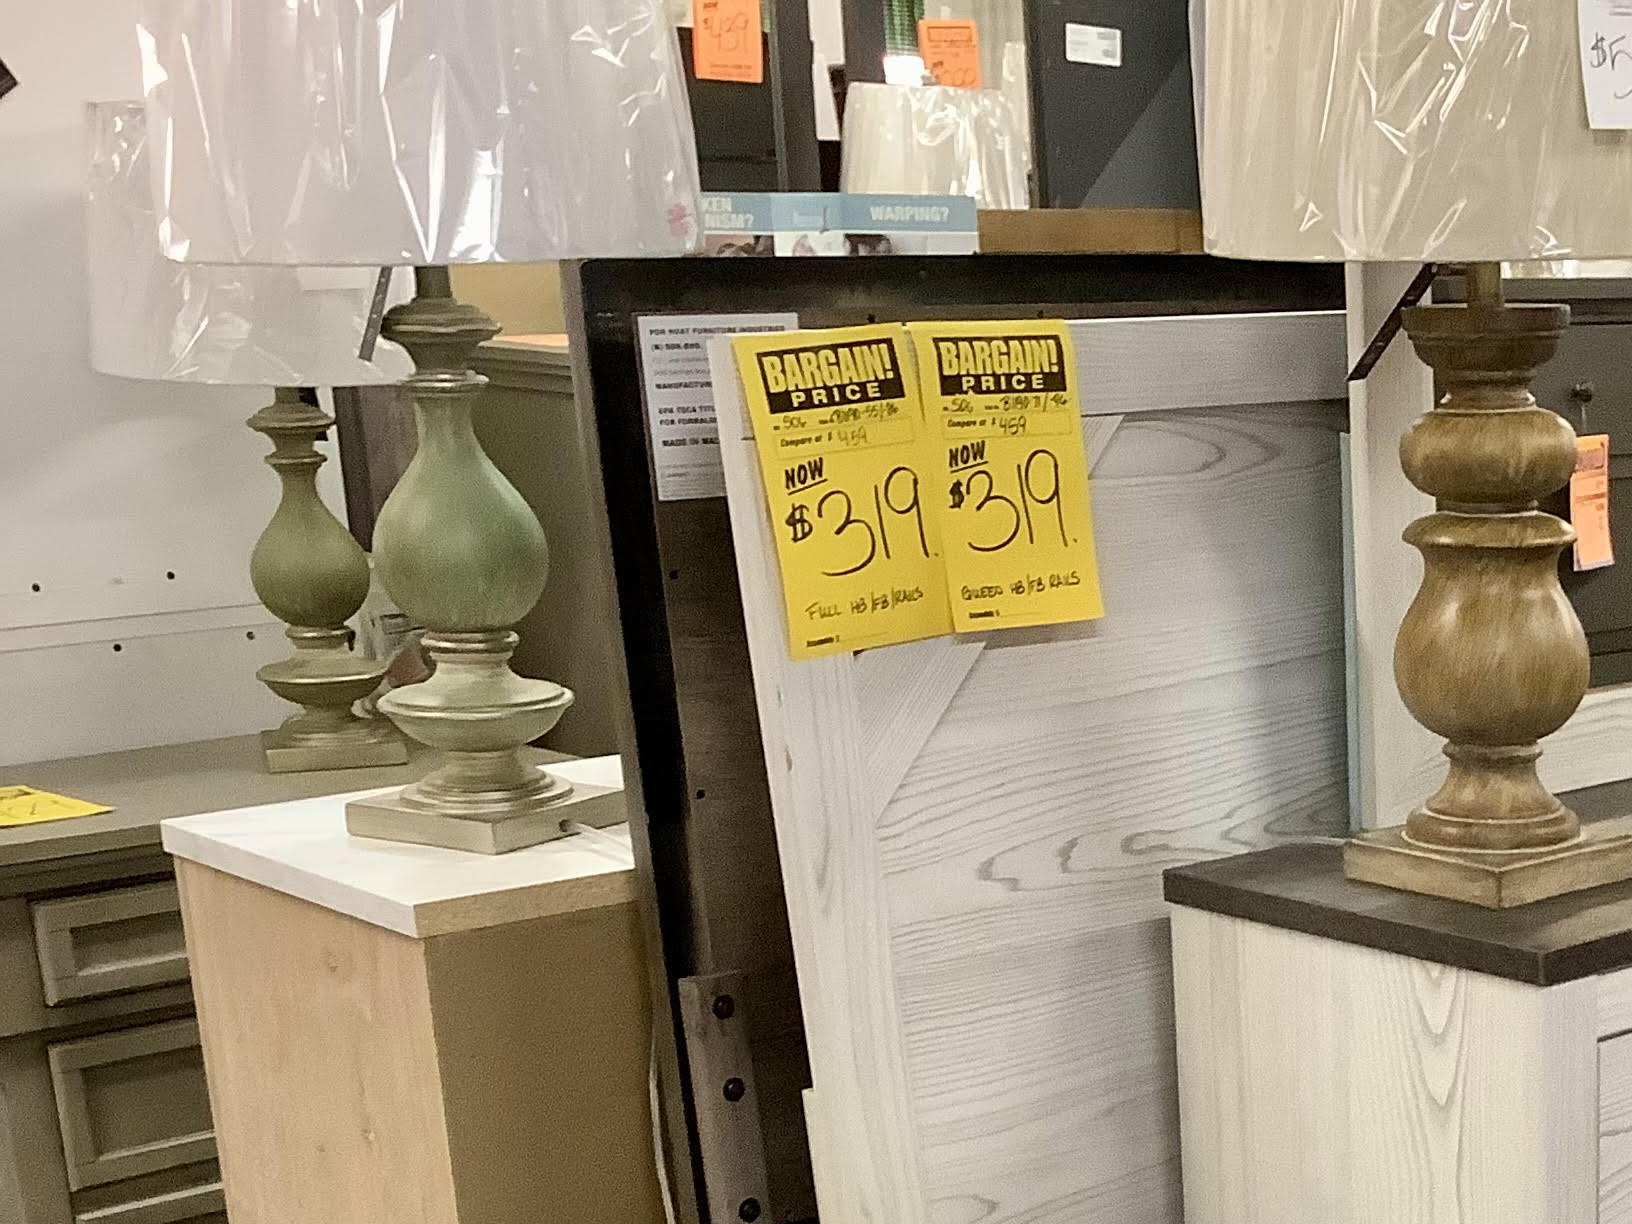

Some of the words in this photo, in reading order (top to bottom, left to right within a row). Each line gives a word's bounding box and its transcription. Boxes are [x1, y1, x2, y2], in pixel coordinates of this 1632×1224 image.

[870, 205, 949, 222] WARPING?
[692, 326, 737, 334] FURNITURE
[937, 339, 1060, 376] BARGAIN!
[761, 343, 894, 393] BARGAIN!
[961, 374, 1045, 391] PRICE
[790, 382, 882, 408] PRICE
[947, 420, 977, 429] Compare
[662, 438, 687, 447] MADE
[780, 437, 813, 448] Compare
[948, 440, 986, 468] NOW
[785, 457, 824, 490] NOW
[804, 601, 842, 620] FULL
